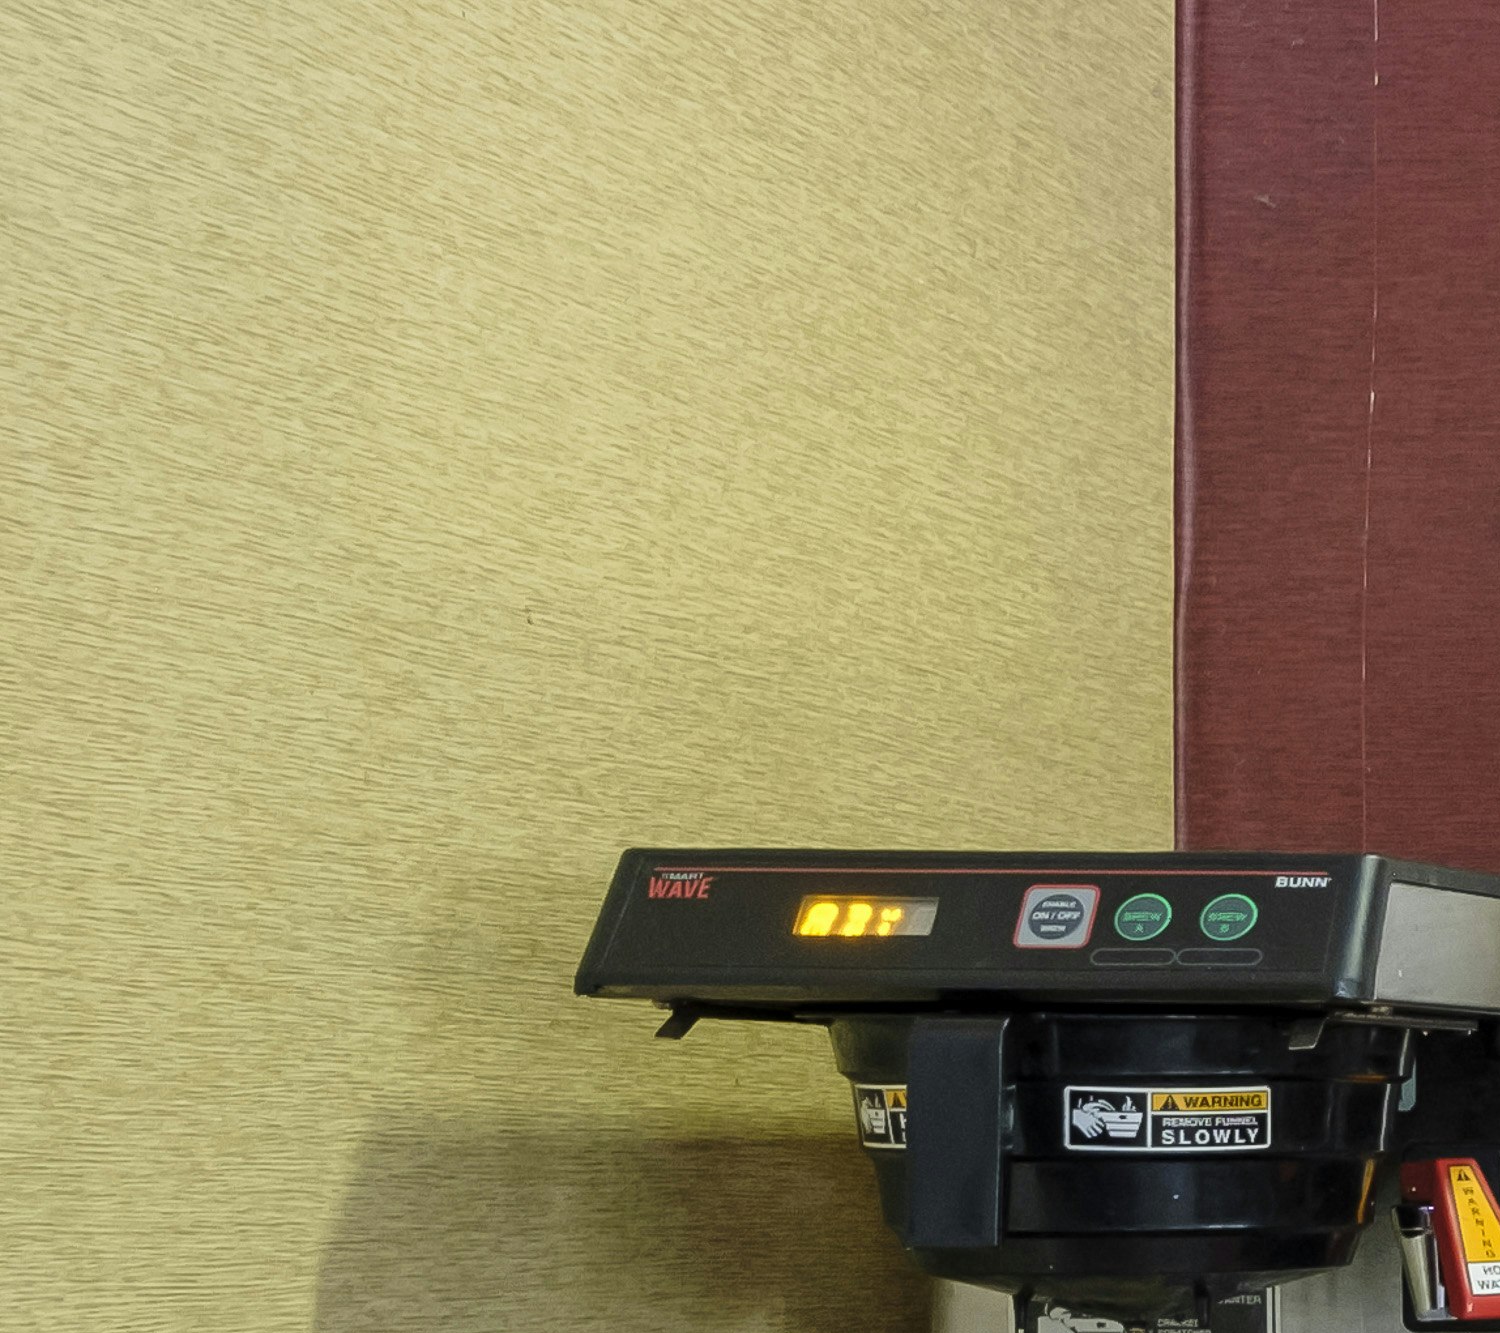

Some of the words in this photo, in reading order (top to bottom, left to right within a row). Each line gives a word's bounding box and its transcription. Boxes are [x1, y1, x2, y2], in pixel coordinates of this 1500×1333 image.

[648, 876, 714, 898] WAVE
[1275, 876, 1329, 889] BUNN
[1183, 1094, 1262, 1107] WARNING
[1162, 1117, 1212, 1127] REMOVE
[1215, 1117, 1258, 1126] FUNNEL
[1162, 1128, 1259, 1145] SLOWLY
